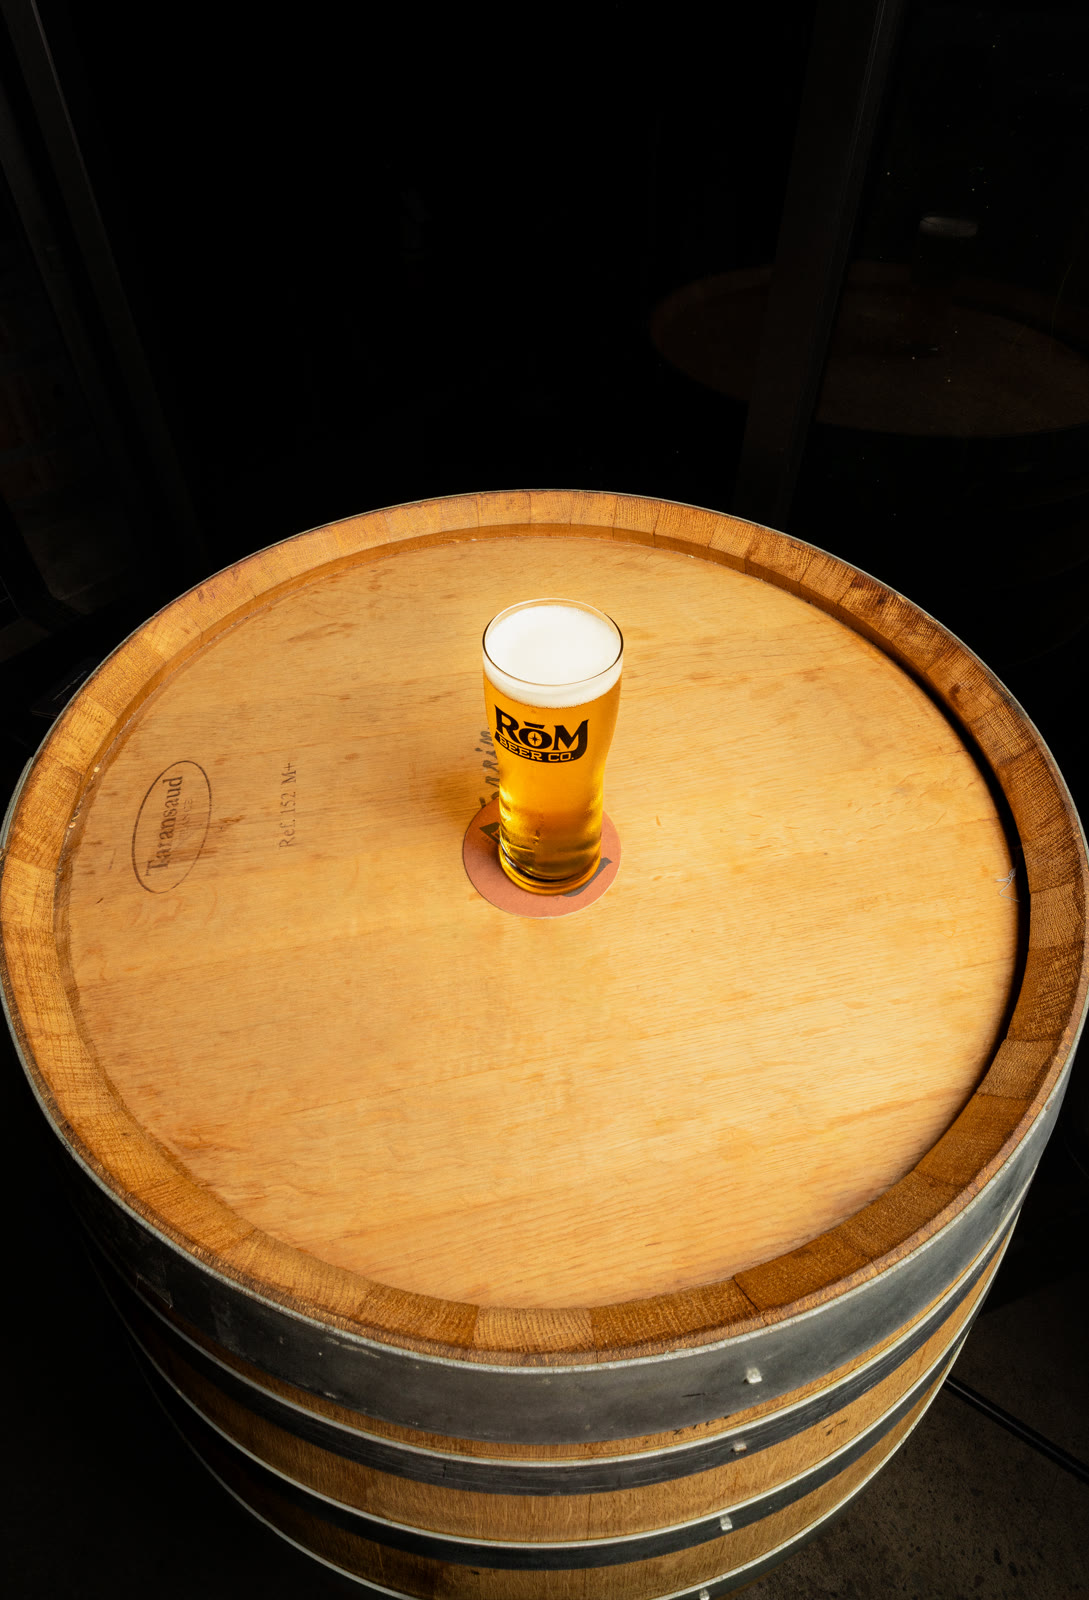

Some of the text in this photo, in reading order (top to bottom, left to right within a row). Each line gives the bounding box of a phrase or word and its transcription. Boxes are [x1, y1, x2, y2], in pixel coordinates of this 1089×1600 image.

[498, 734, 543, 761] BEER
[145, 775, 183, 877] Taransaud
[278, 762, 297, 849] Ref. 152 M+
